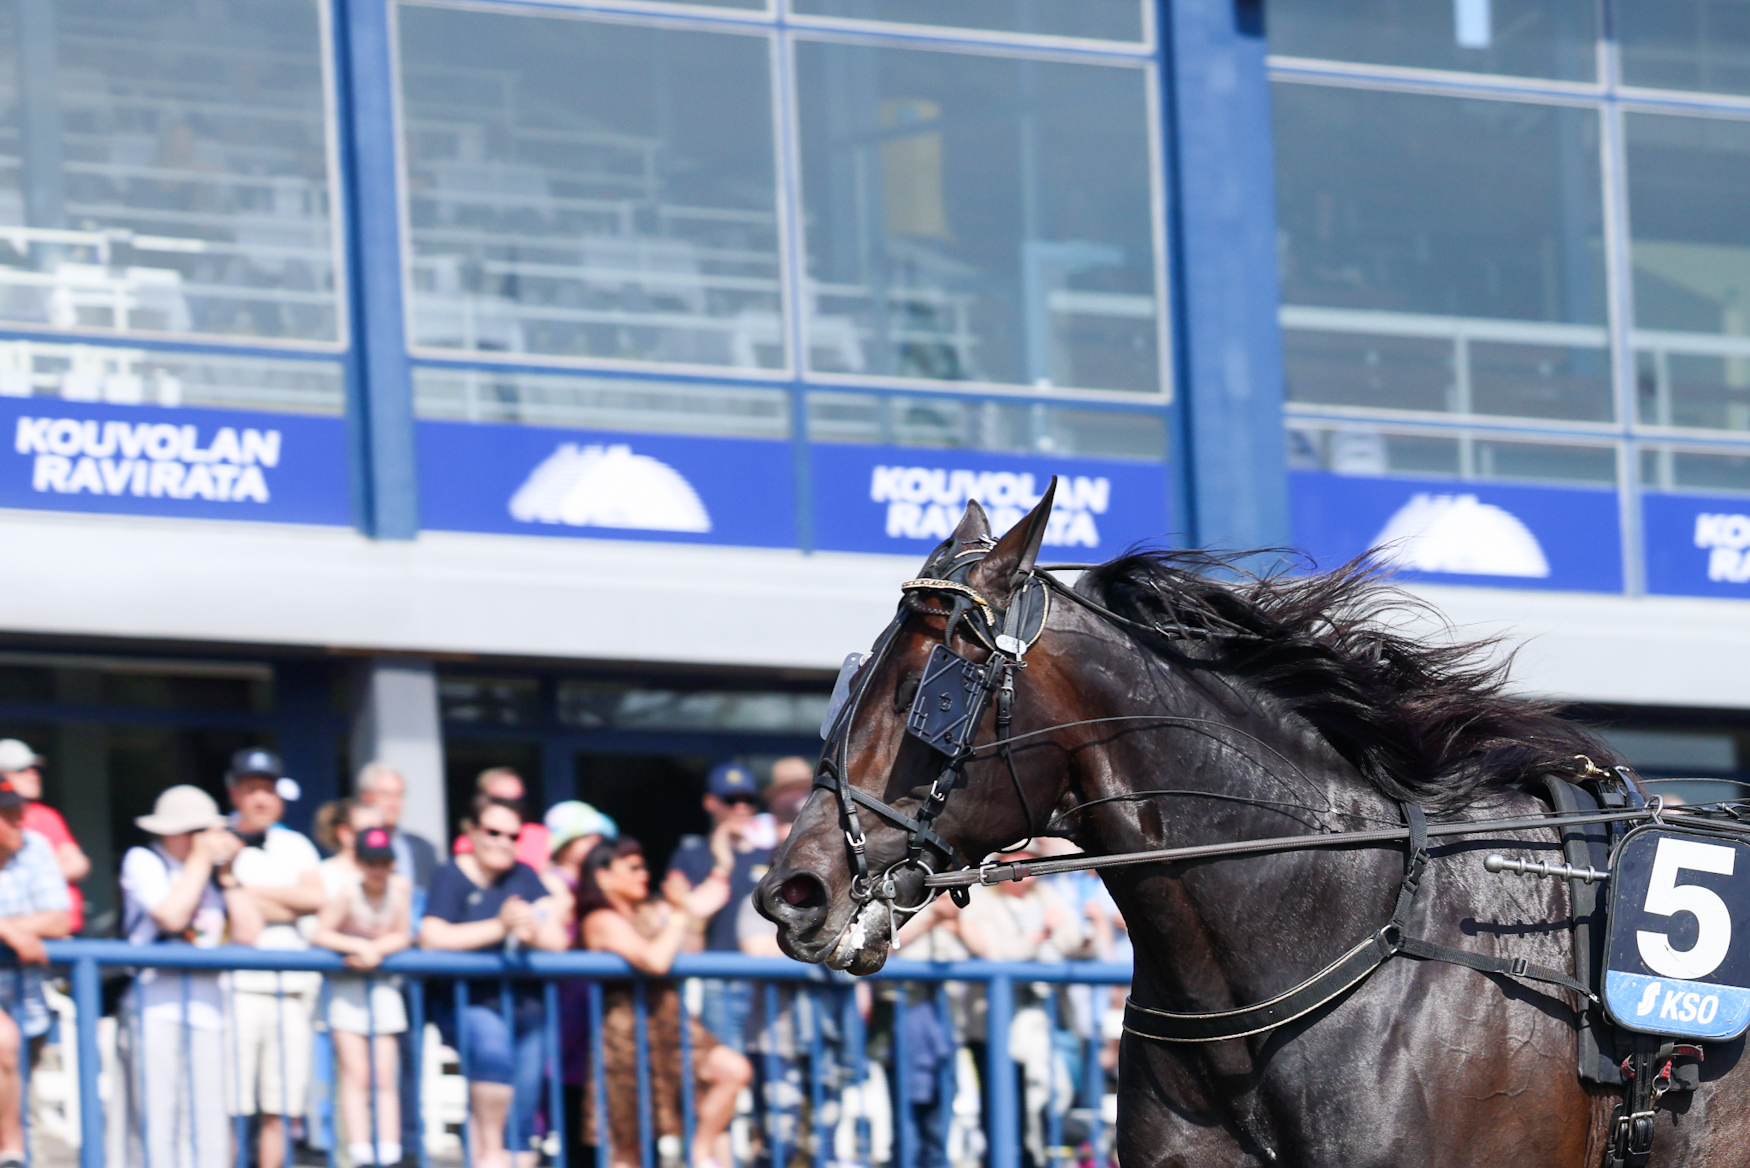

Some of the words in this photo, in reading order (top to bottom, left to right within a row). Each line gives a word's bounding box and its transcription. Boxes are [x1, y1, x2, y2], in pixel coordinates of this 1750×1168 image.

[16, 417, 280, 467] KOUVOLAN
[33, 456, 269, 502] RAVIRATA
[871, 466, 1110, 514] KOUVOLAN
[1635, 836, 1736, 980] 5
[1660, 989, 1719, 1024] KSO
